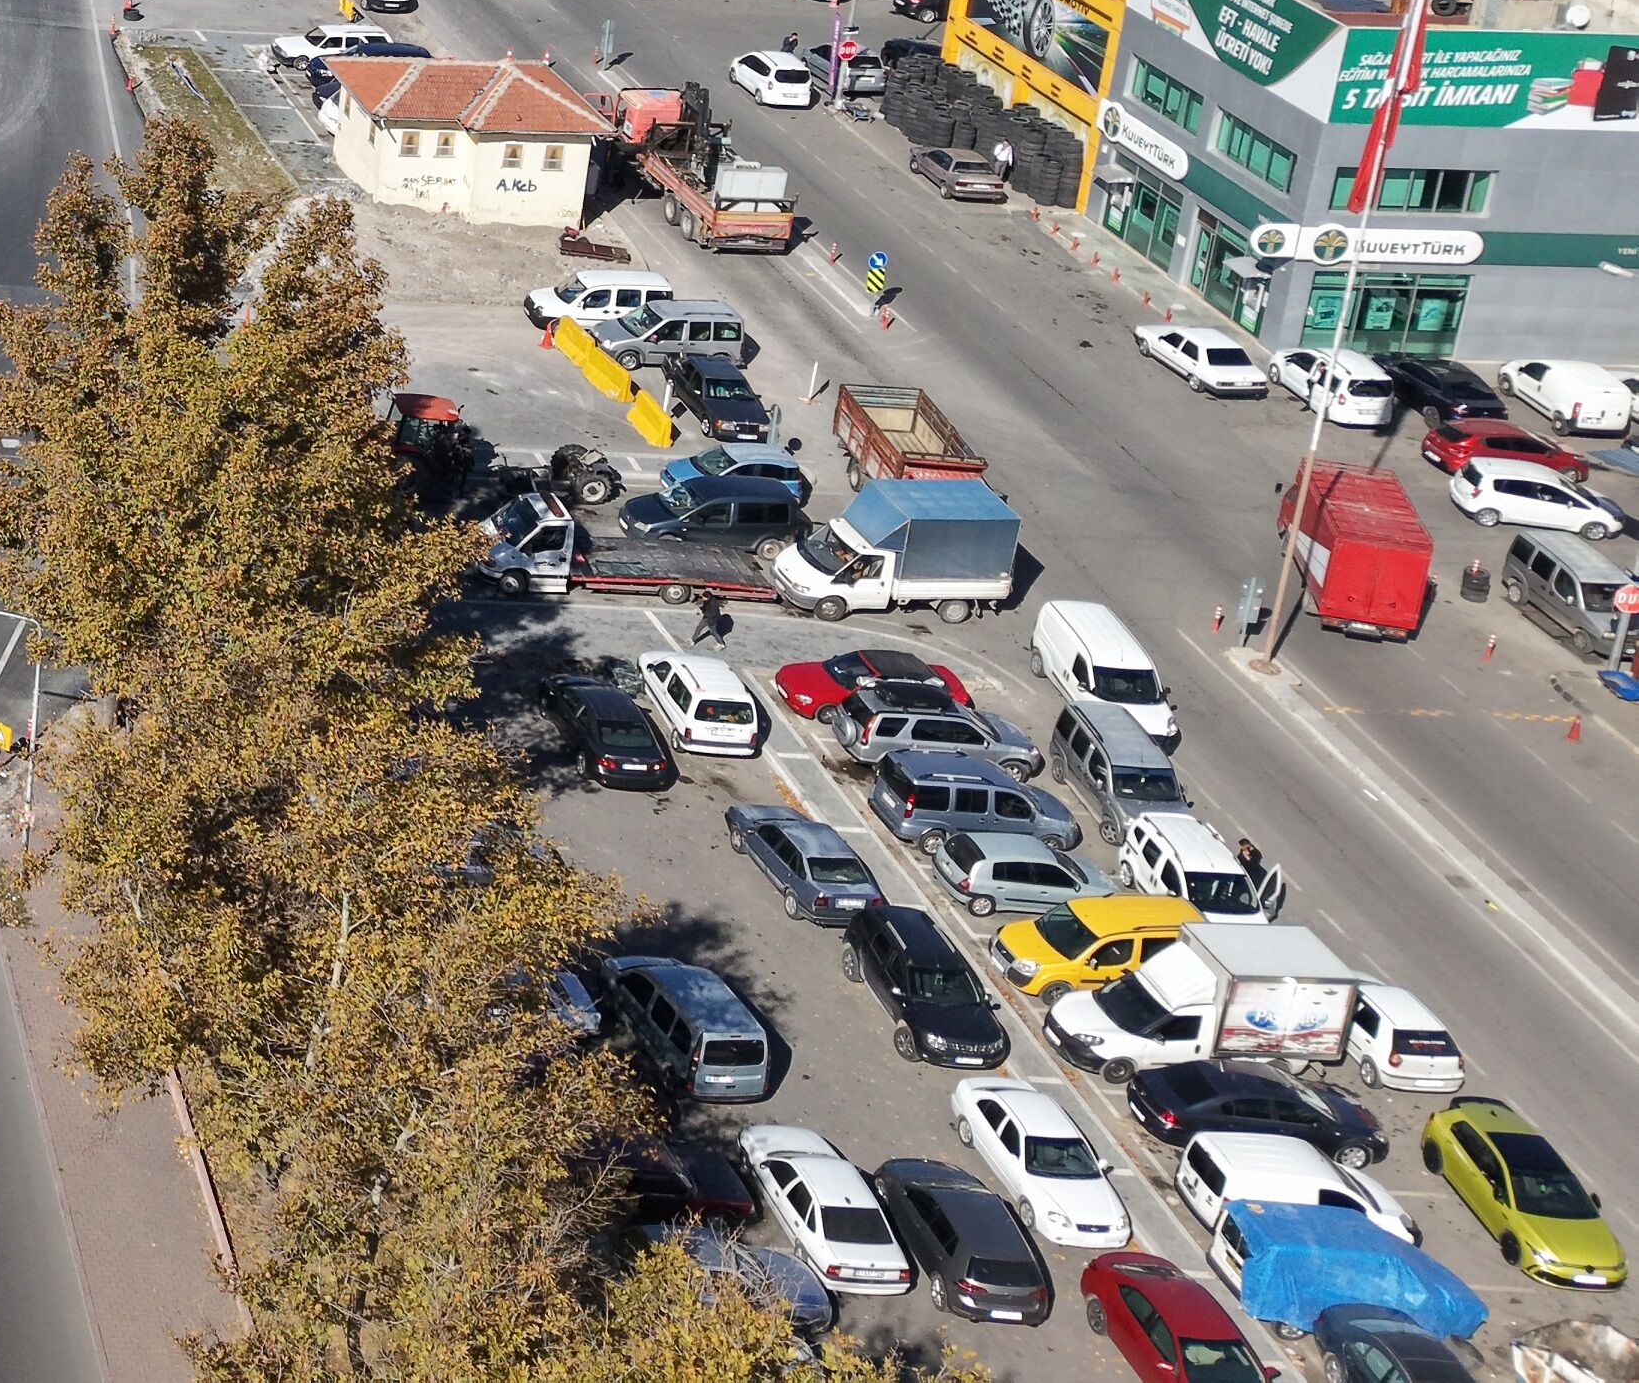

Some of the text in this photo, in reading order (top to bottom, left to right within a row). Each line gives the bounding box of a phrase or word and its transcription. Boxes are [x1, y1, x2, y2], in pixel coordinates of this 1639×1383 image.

[1241, 17, 1281, 53] HAVALE
[839, 45, 857, 54] DUR
[1359, 51, 1394, 67] SAĞLA
[1433, 79, 1521, 107] İMKANI
